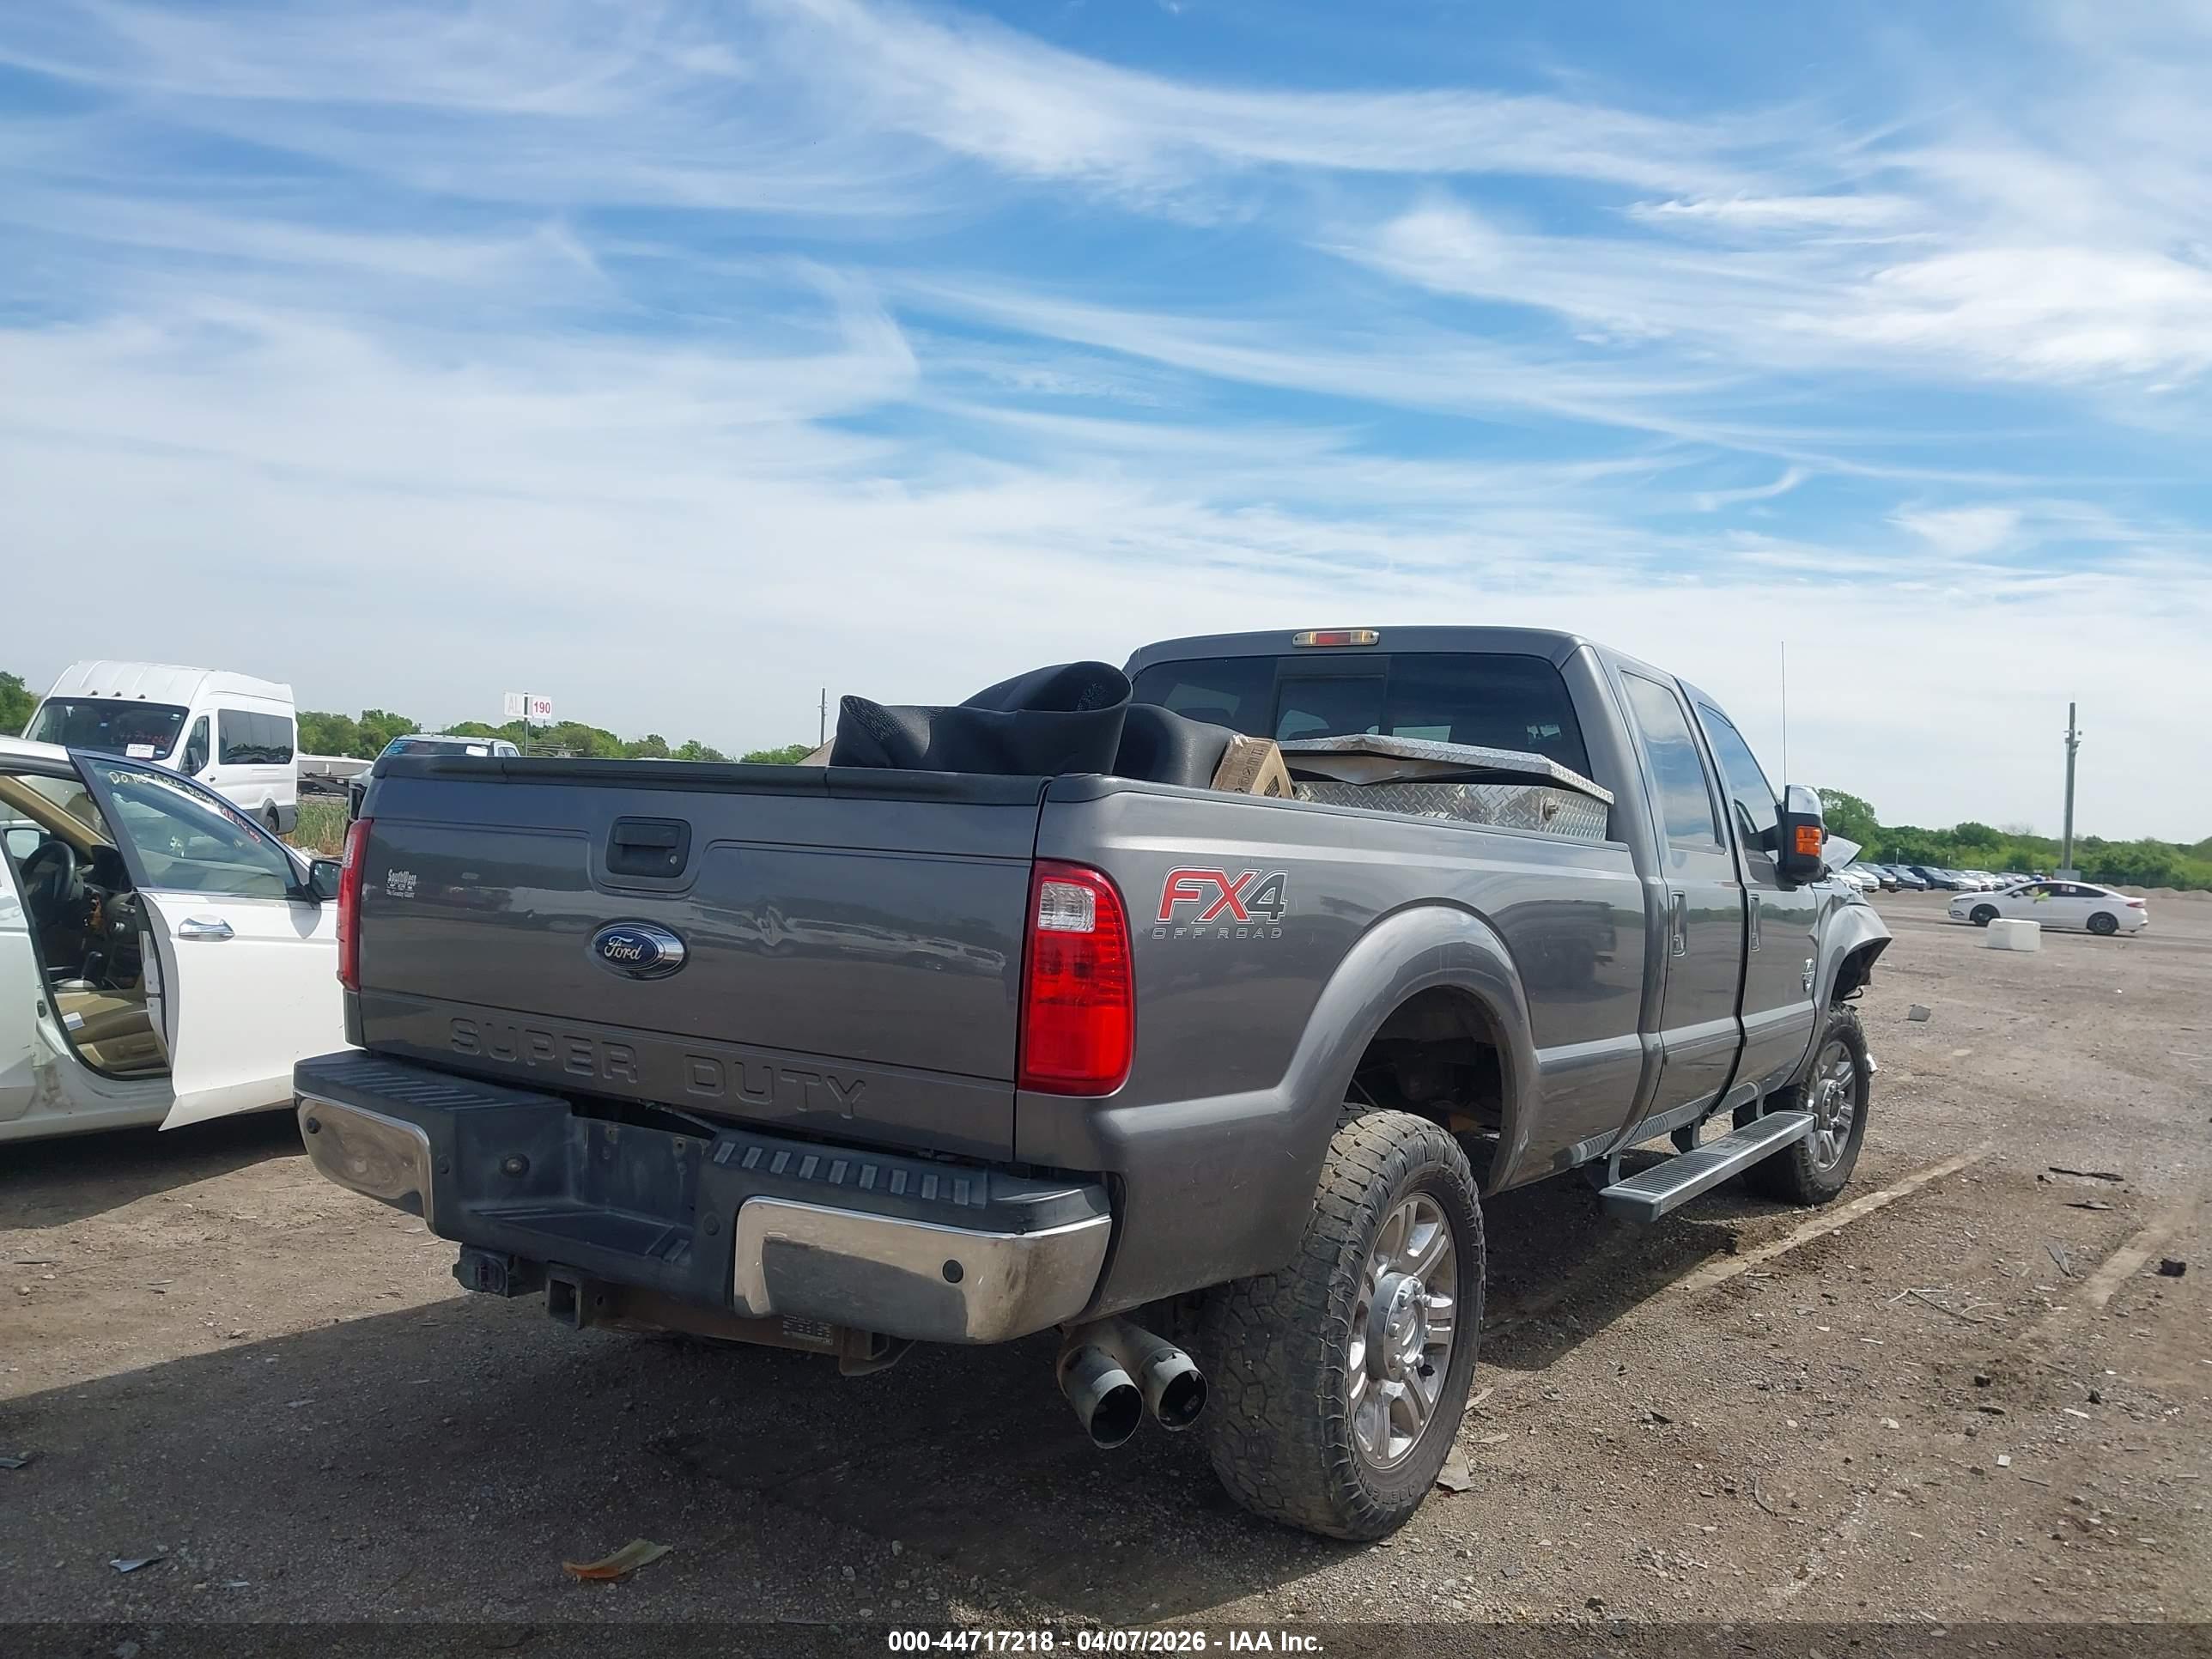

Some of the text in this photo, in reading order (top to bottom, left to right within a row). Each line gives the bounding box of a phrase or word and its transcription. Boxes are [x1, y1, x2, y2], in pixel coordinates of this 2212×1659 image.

[507, 696, 551, 714] AL 190
[1154, 865, 1288, 925] FX4
[1152, 927, 1283, 939] OFF ROAD
[604, 935, 644, 961] Ford
[449, 1017, 867, 1120] SUPER DUTY
